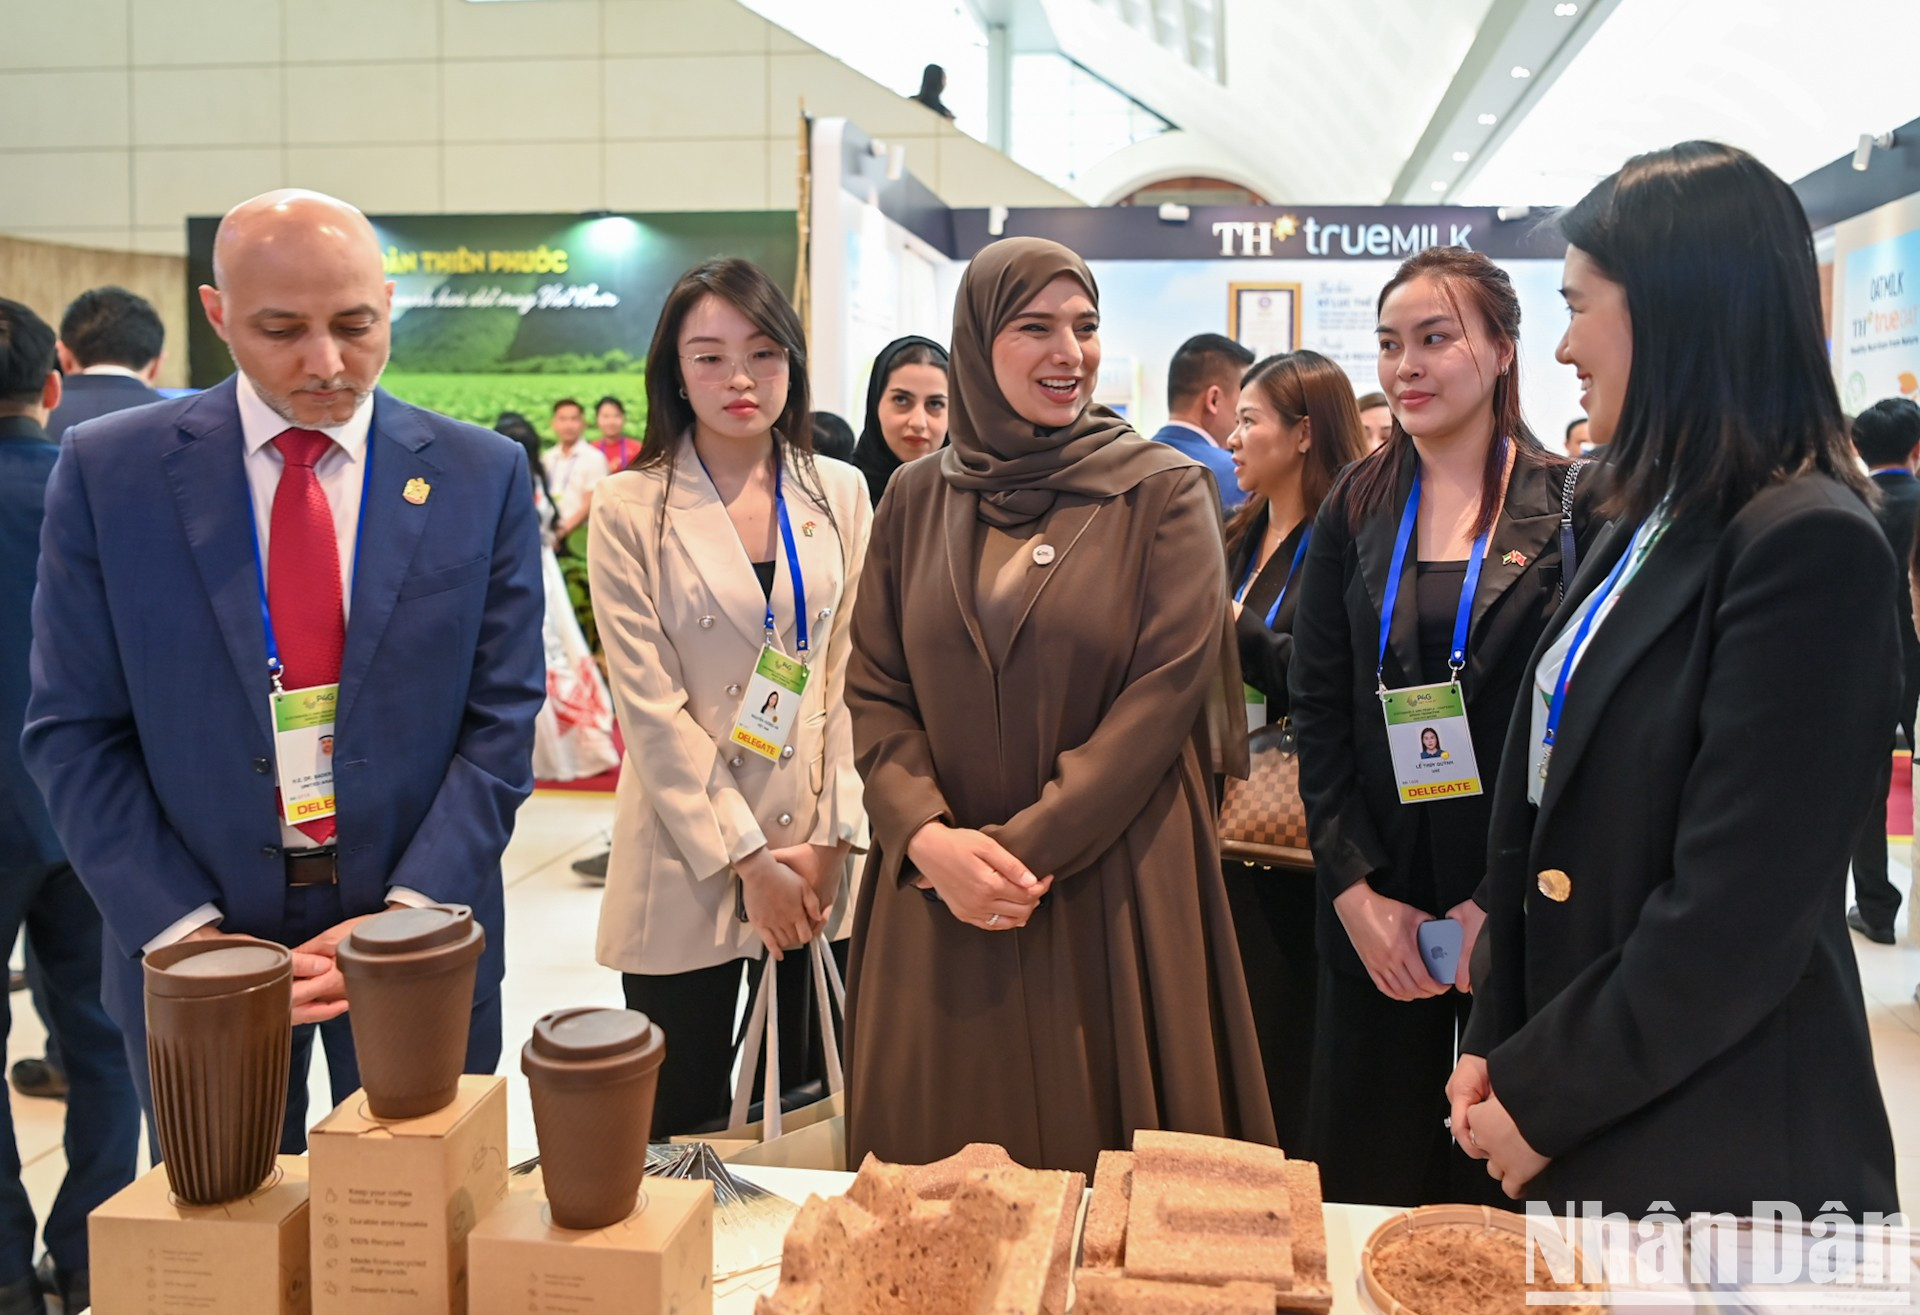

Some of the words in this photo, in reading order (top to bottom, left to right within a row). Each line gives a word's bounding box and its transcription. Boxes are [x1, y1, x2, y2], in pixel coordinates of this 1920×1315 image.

[1212, 222, 1274, 256] TH
[737, 731, 777, 756] DELEGATE
[1408, 782, 1471, 797] DELEGATE
[297, 798, 335, 815] DELE
